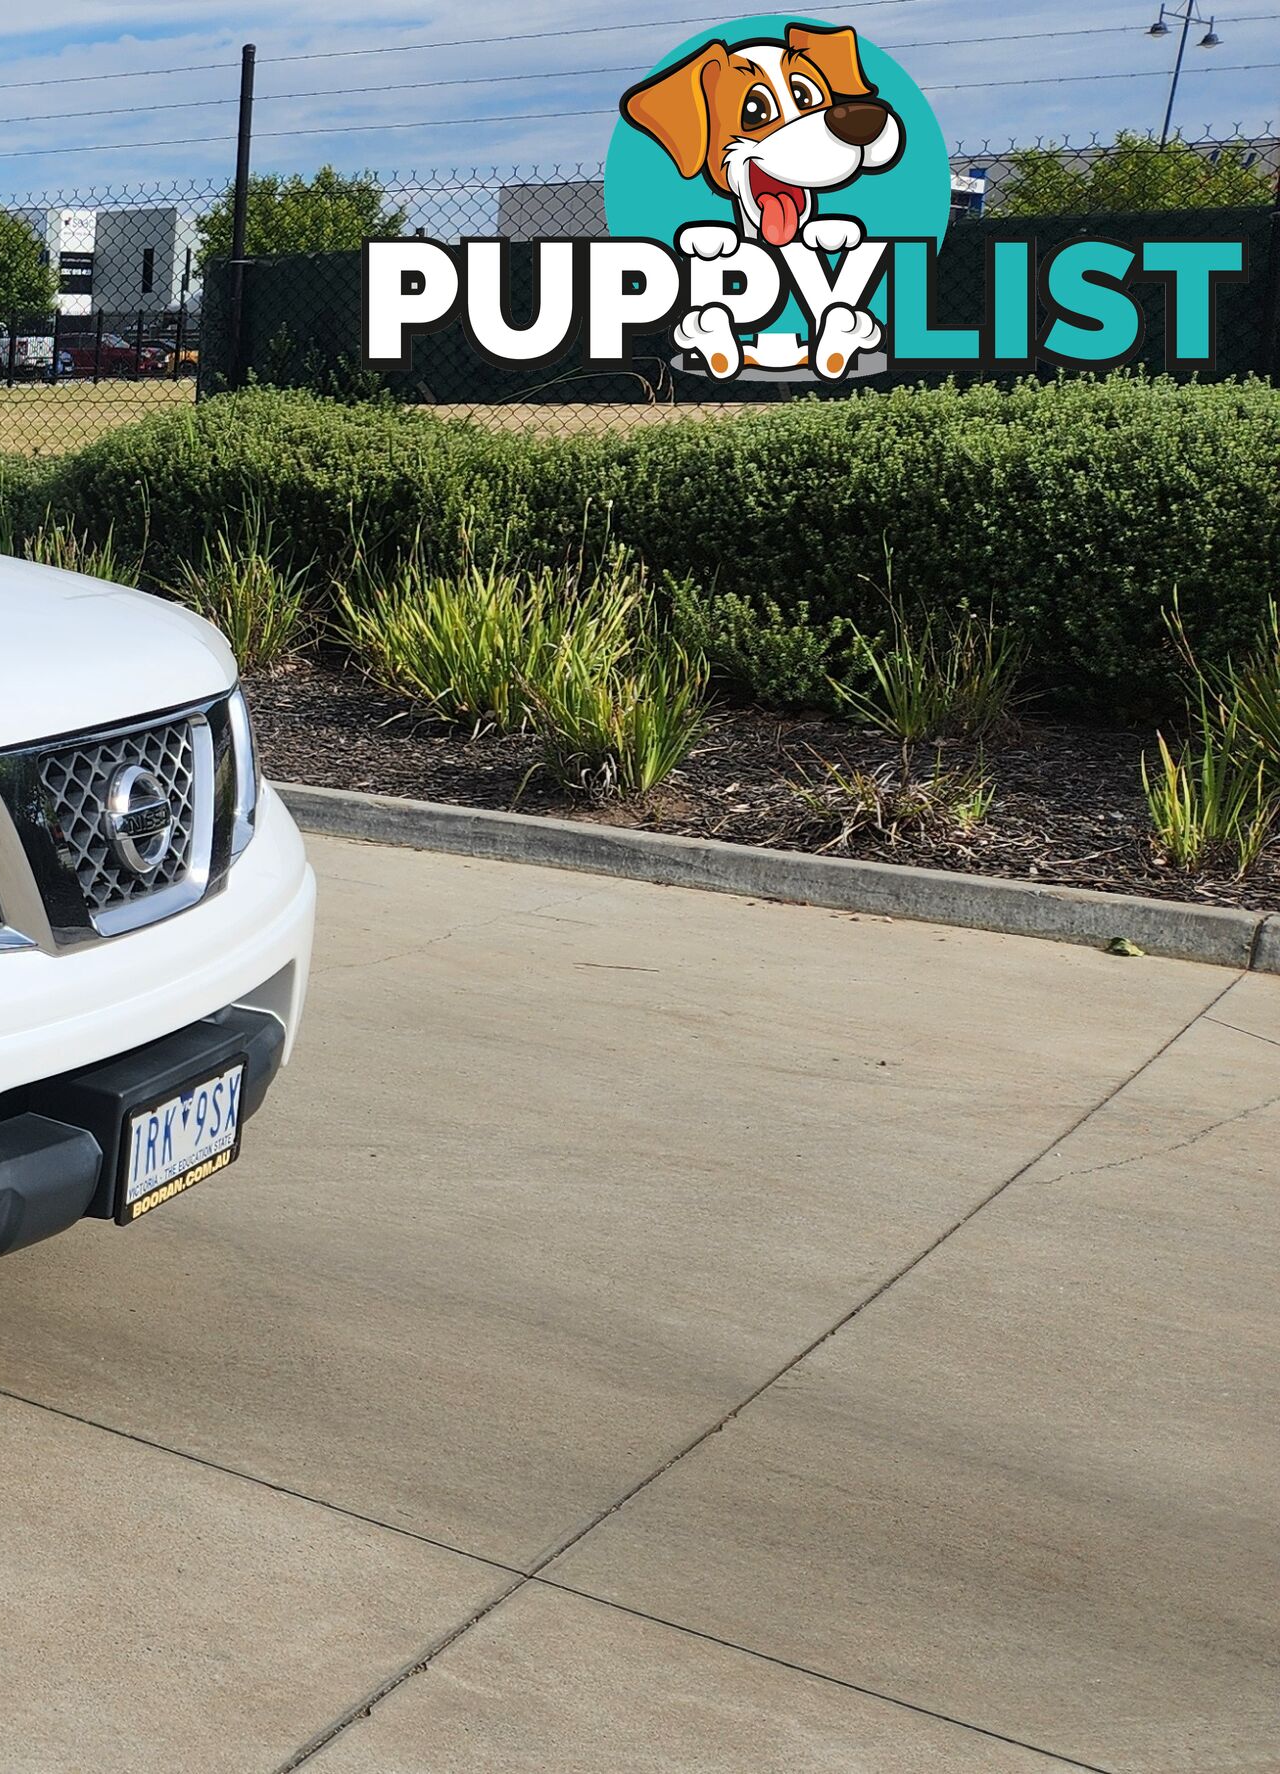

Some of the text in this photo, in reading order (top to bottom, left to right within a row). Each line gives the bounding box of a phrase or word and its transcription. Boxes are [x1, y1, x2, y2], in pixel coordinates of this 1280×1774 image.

[133, 1073, 241, 1182] 1RK 9SX
[128, 1176, 159, 1201] VICTORIA
[164, 1164, 177, 1180] THE
[178, 1145, 213, 1172] EDUCATION
[213, 1133, 233, 1152] STATE
[132, 1149, 232, 1219] BOORAN.COM.AU
